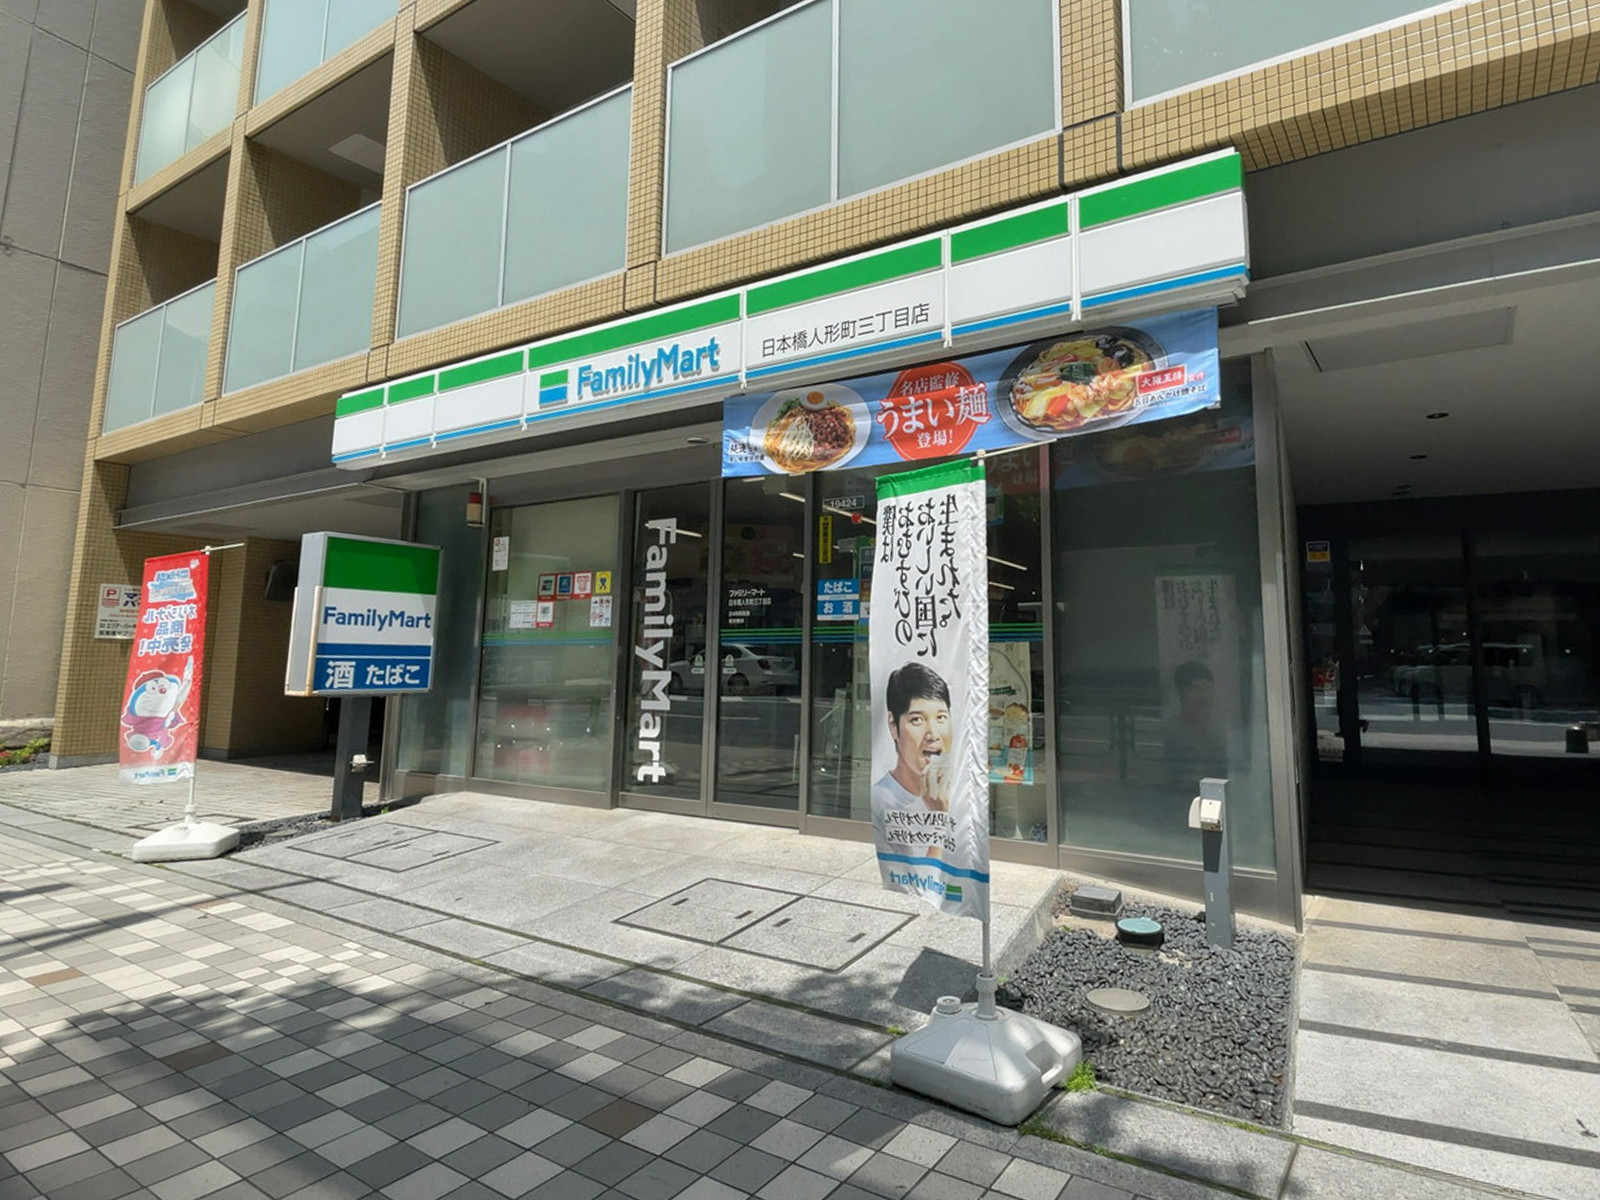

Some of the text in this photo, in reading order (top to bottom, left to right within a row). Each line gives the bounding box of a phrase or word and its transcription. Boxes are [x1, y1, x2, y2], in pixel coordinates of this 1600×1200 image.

[761, 303, 930, 358] 日本橋人形町三丁目店
[577, 336, 720, 396] FamilyMart
[900, 371, 960, 396] 名店監修
[875, 381, 992, 436] うまい麺
[917, 429, 953, 449] 登場!
[824, 581, 853, 594] たばこ
[323, 606, 431, 631] FamilyMart
[635, 517, 677, 783] FamilyMart
[324, 660, 421, 689] 酒 たばこ
